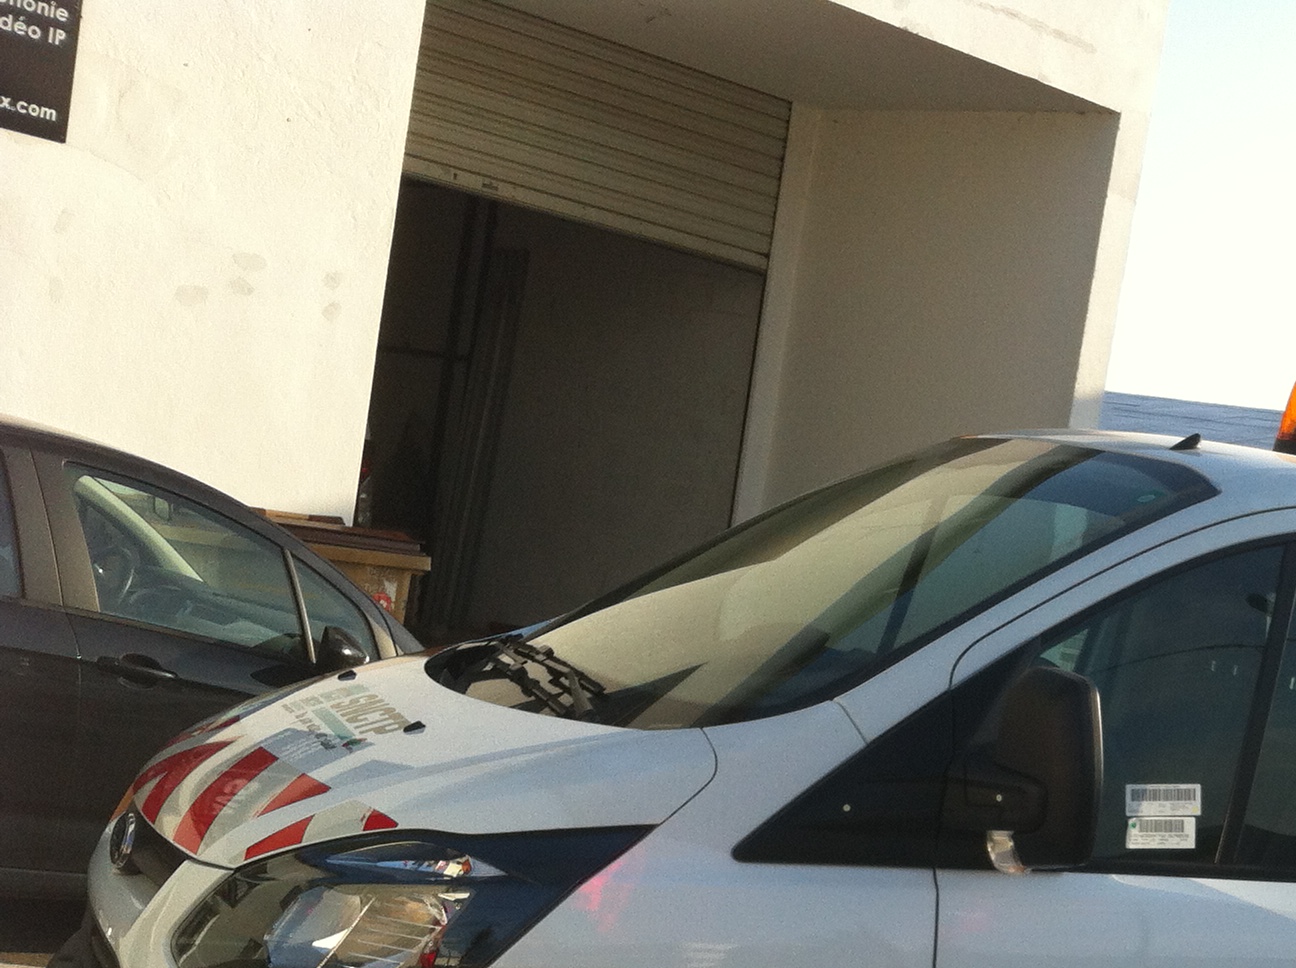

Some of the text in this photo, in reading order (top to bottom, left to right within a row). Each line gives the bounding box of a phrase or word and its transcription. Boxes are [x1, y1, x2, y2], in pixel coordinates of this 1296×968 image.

[0, 0, 69, 22] onie
[0, 14, 67, 46] déo IP
